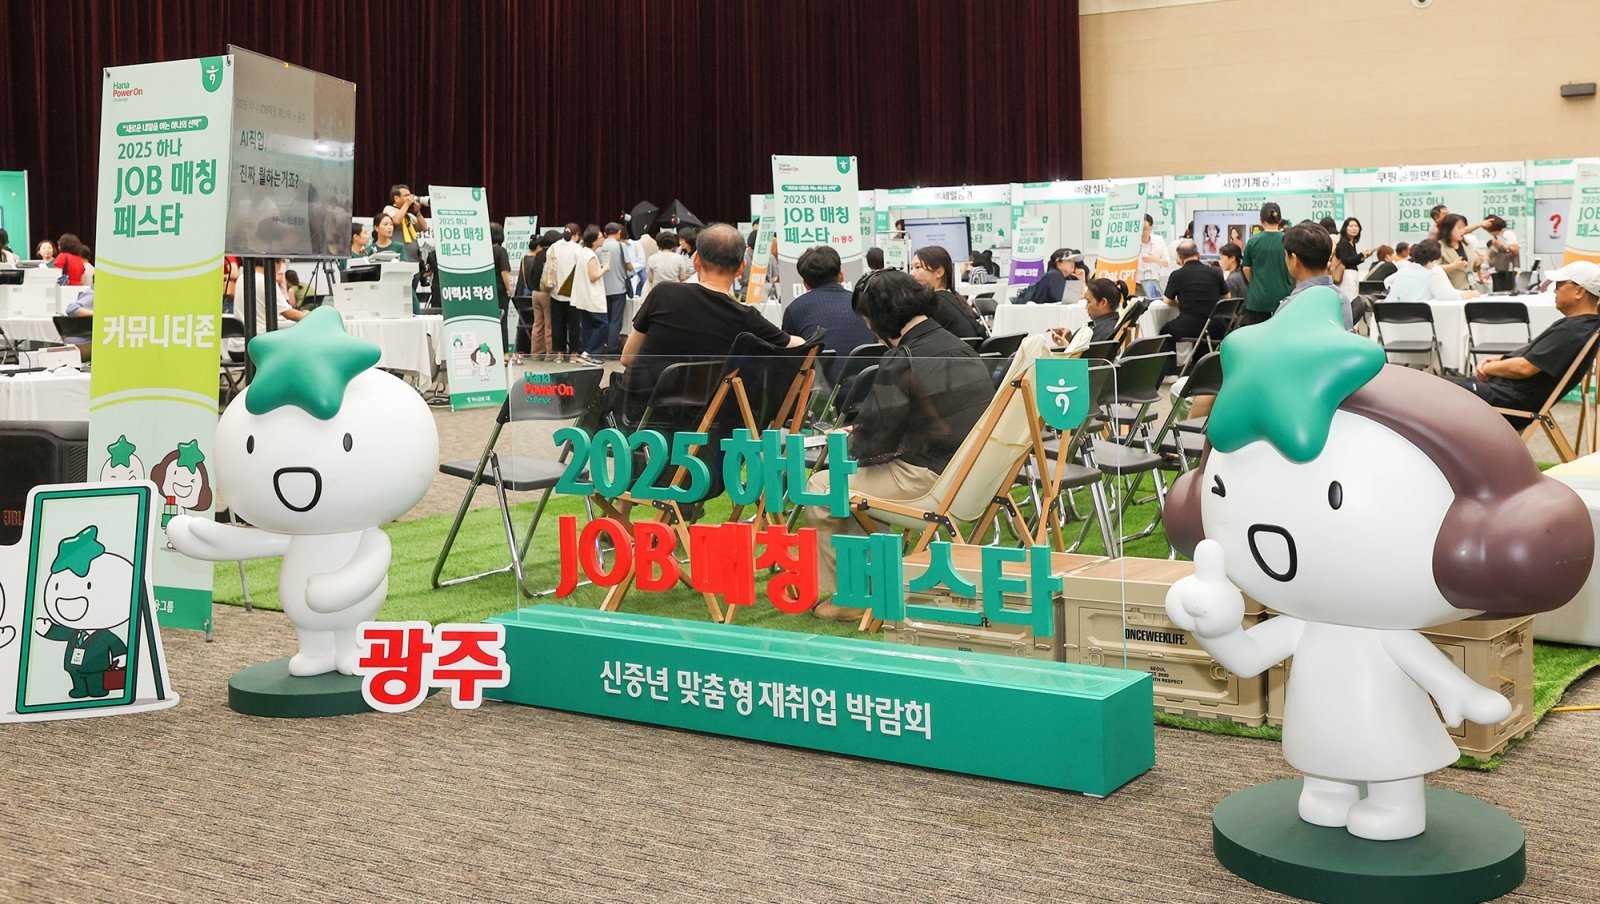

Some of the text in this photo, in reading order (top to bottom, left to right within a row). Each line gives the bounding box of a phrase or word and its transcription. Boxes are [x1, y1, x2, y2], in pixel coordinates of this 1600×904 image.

[113, 81, 130, 90] Hana
[117, 137, 183, 160] 2025 하나
[113, 158, 217, 204] JOB 매칭
[239, 164, 256, 185] 진짜
[783, 194, 826, 204] 2025 하나
[1311, 199, 1334, 209] 2025
[1399, 197, 1424, 207] 2025
[1483, 195, 1509, 204] 2025
[113, 202, 184, 238] 페스타
[783, 206, 850, 226] JOB 매칭
[1399, 209, 1421, 221] JOB
[439, 227, 461, 242] JOB
[463, 227, 485, 241] 매칭
[783, 226, 854, 244] 페스타 in 광주
[1107, 221, 1123, 236] JOB
[1125, 219, 1141, 233] 매칭
[1399, 221, 1430, 233] 페스타
[440, 243, 472, 257] 페스타
[1105, 235, 1128, 248] 페스타
[1120, 268, 1136, 281] GPT
[442, 285, 494, 302] 이력서 작성
[102, 313, 216, 349] 커뮤니티존
[523, 371, 551, 384] Hana
[523, 382, 575, 396] Power On
[554, 426, 858, 518] 2025 하나
[3, 509, 24, 527] JBL
[556, 515, 1064, 638] JOB 매칭 페스타
[359, 628, 503, 705] 광주
[599, 660, 932, 741] 신중년 맞춤형 재취업 박람회
